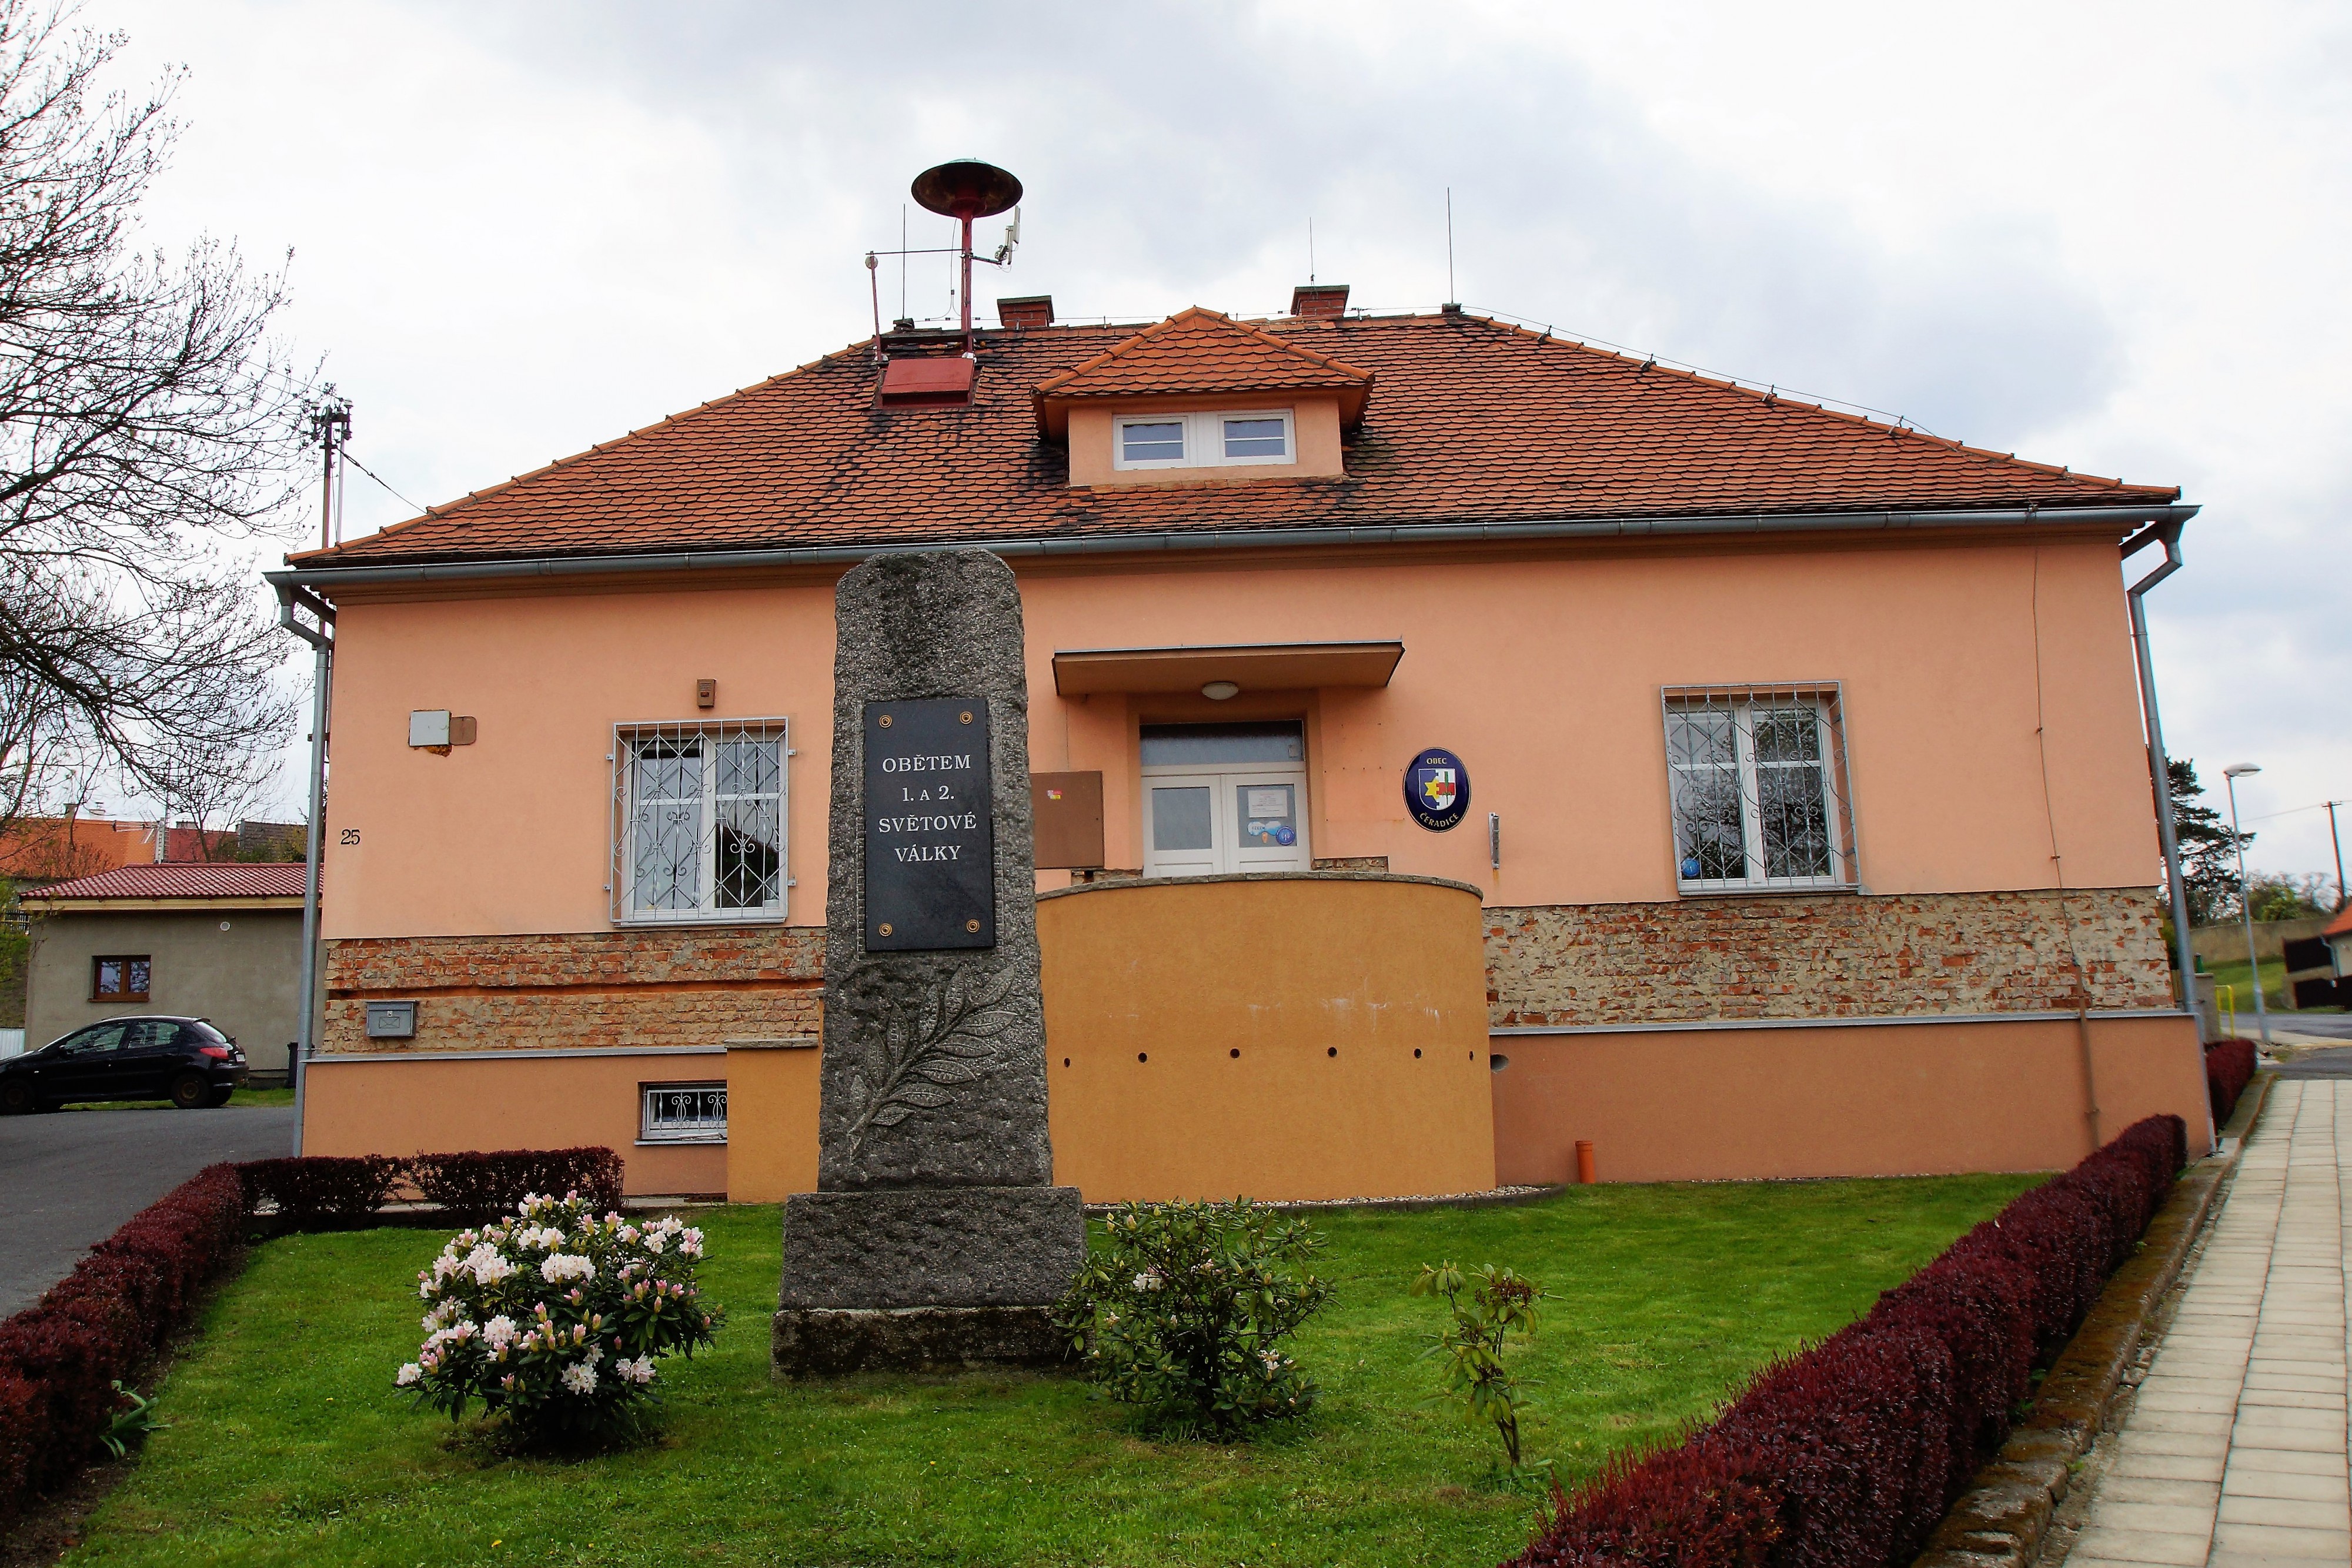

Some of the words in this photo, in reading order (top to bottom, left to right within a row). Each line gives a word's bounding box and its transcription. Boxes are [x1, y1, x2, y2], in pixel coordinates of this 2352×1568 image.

[882, 754, 971, 773] OBĚTEM
[901, 787, 915, 802] 1.
[919, 789, 931, 801] A
[938, 785, 955, 801] 2.
[878, 811, 977, 833] SVĚTOVÉ
[1419, 811, 1459, 827] ČERADICE
[340, 829, 360, 845] 25
[894, 844, 961, 862] VÁLKY
